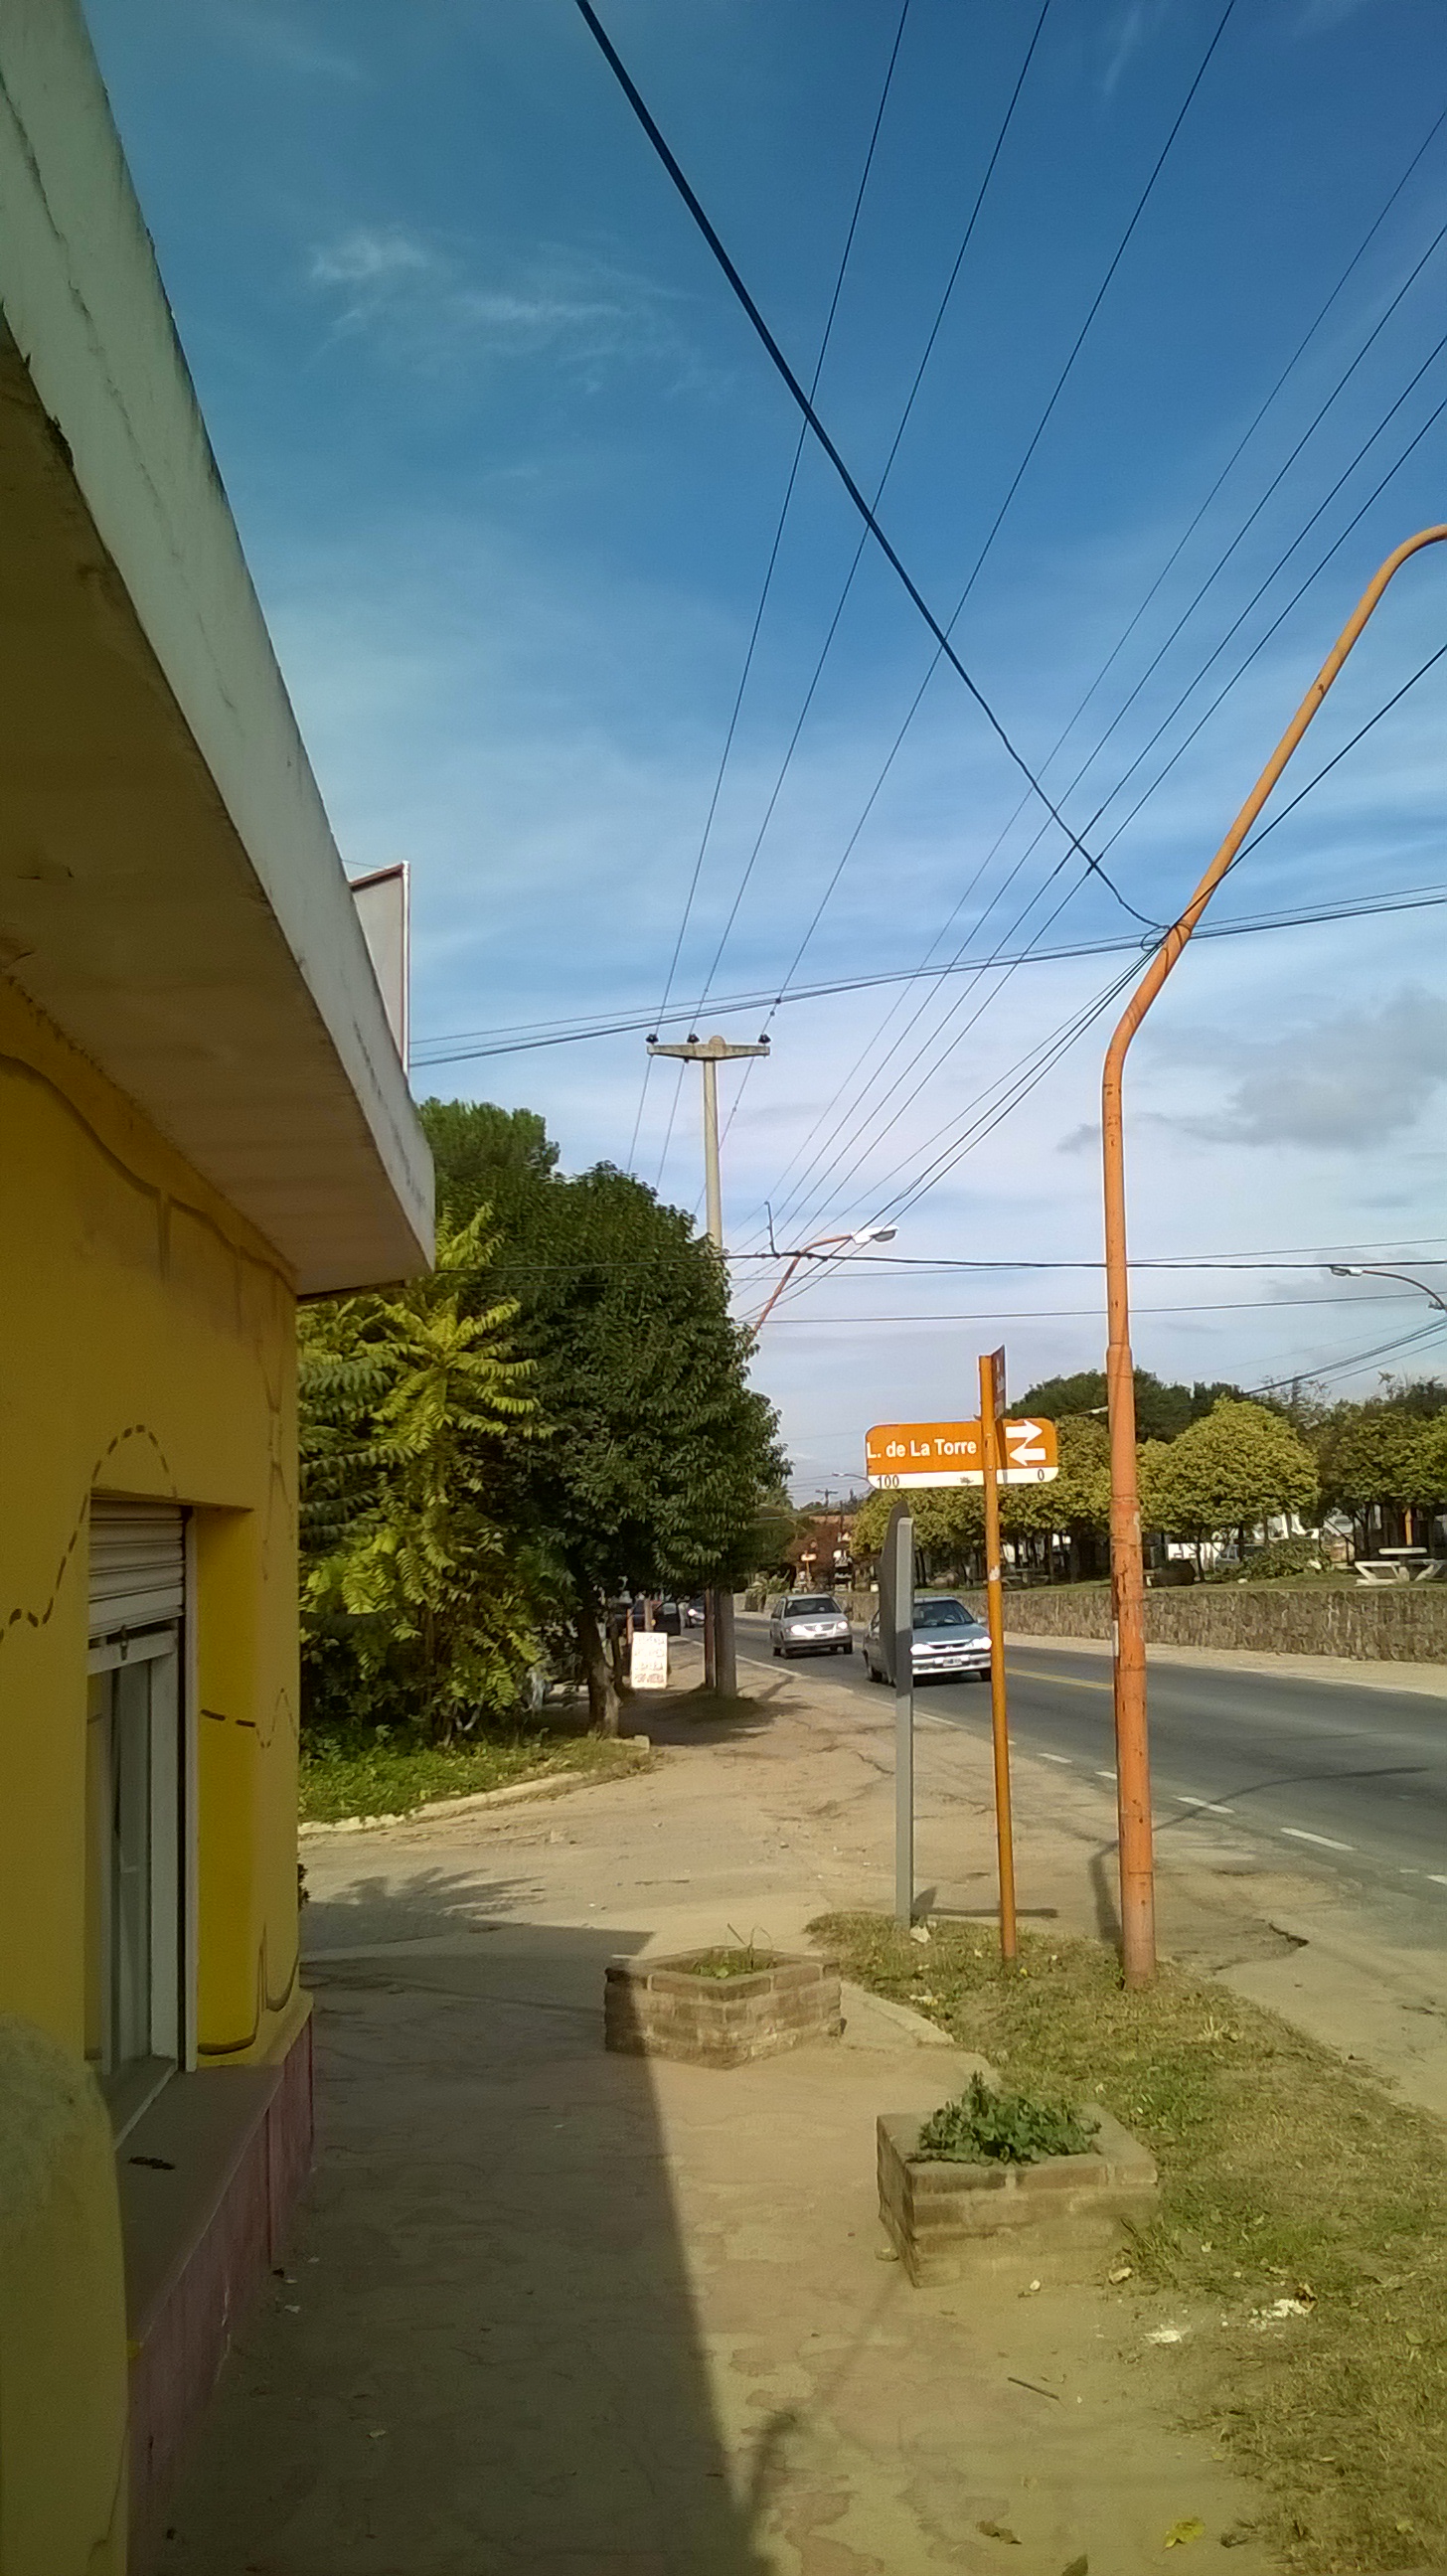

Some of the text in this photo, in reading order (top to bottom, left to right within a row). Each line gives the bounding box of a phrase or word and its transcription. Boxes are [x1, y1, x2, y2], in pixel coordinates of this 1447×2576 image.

[867, 1438, 977, 1459] L. de La Torre
[877, 1475, 899, 1489] 100
[1037, 1468, 1045, 1482] 0
